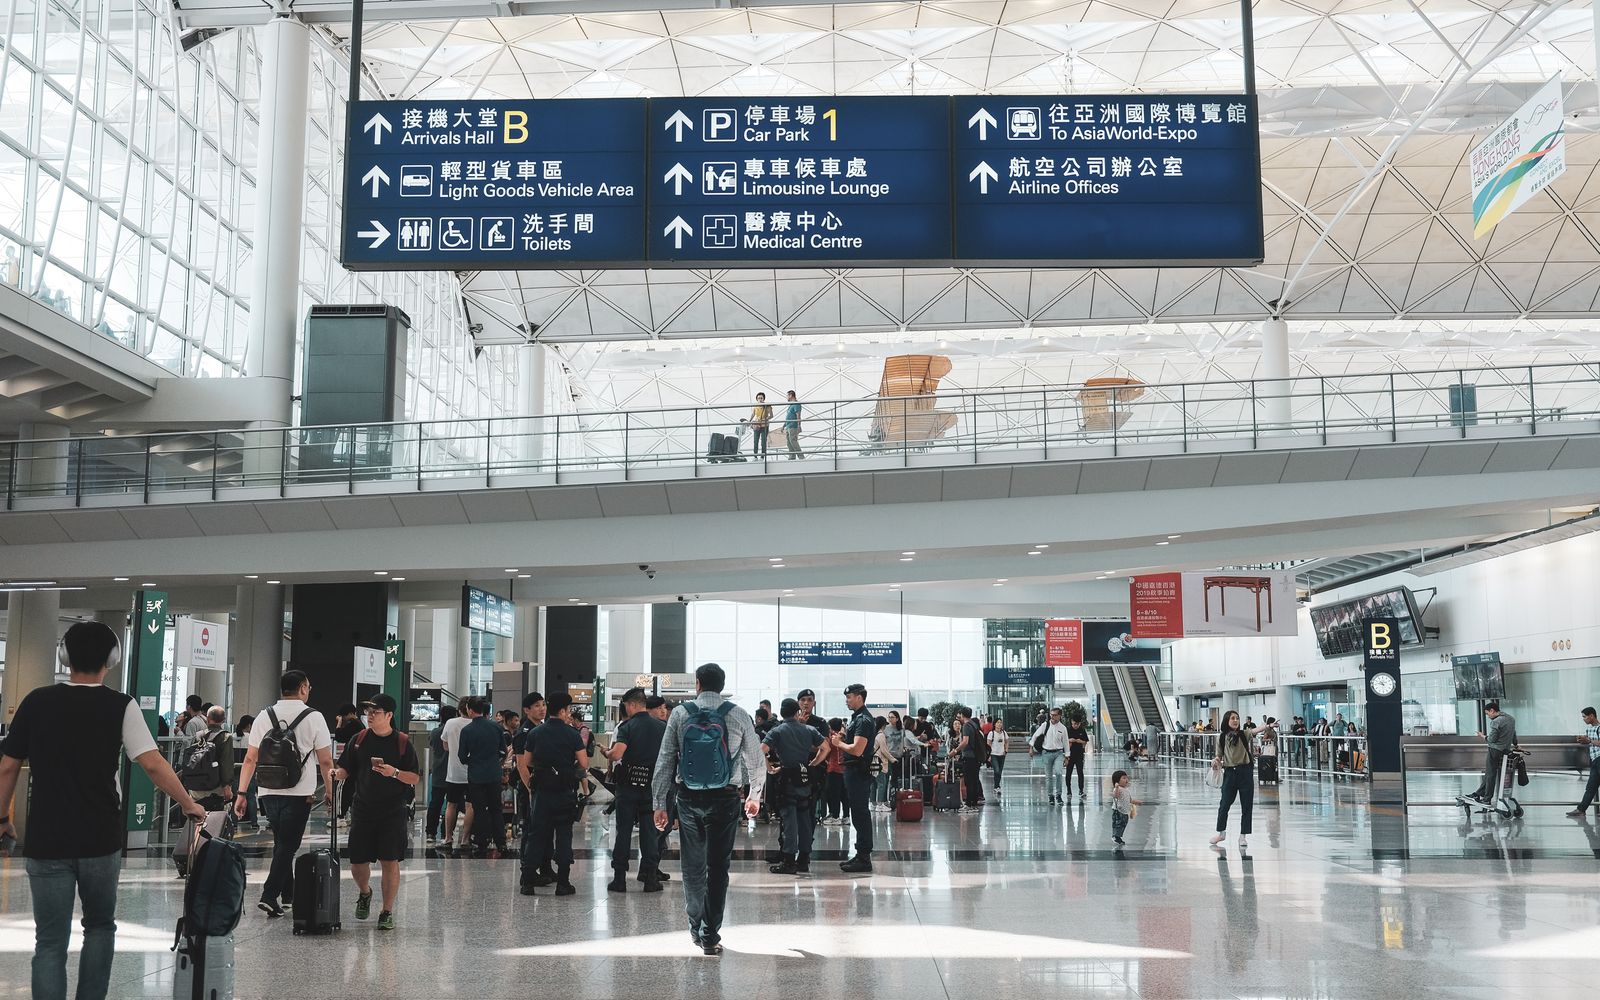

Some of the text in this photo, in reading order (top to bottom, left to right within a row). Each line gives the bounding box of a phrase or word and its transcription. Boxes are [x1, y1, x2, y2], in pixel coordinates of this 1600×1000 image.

[402, 107, 498, 129] 接機大堂
[744, 104, 817, 126] 停車場
[1049, 102, 1247, 124] 往亞洲國際博覽館
[503, 110, 529, 144] B
[710, 112, 732, 139] P
[743, 127, 810, 142] Car Park
[822, 108, 837, 141] 1
[1048, 126, 1198, 143] To AsiaWorld-Expo
[401, 130, 494, 145] Arrivals Hall
[1473, 129, 1520, 180] HONG KONG
[440, 159, 563, 182] 輕型貨車區
[743, 157, 868, 179] 專車候車處
[1008, 156, 1183, 178] 航空公司辦公室
[439, 182, 635, 201] Light Goods Vehicle Area
[743, 181, 890, 198] Limousine Lounge
[1008, 180, 1119, 195] Airline Offices
[522, 213, 594, 235] 洗手間
[743, 211, 843, 233] 醫療中心
[521, 236, 572, 251] Toilets
[743, 234, 863, 249] Medical Centre
[1371, 622, 1391, 649] B
